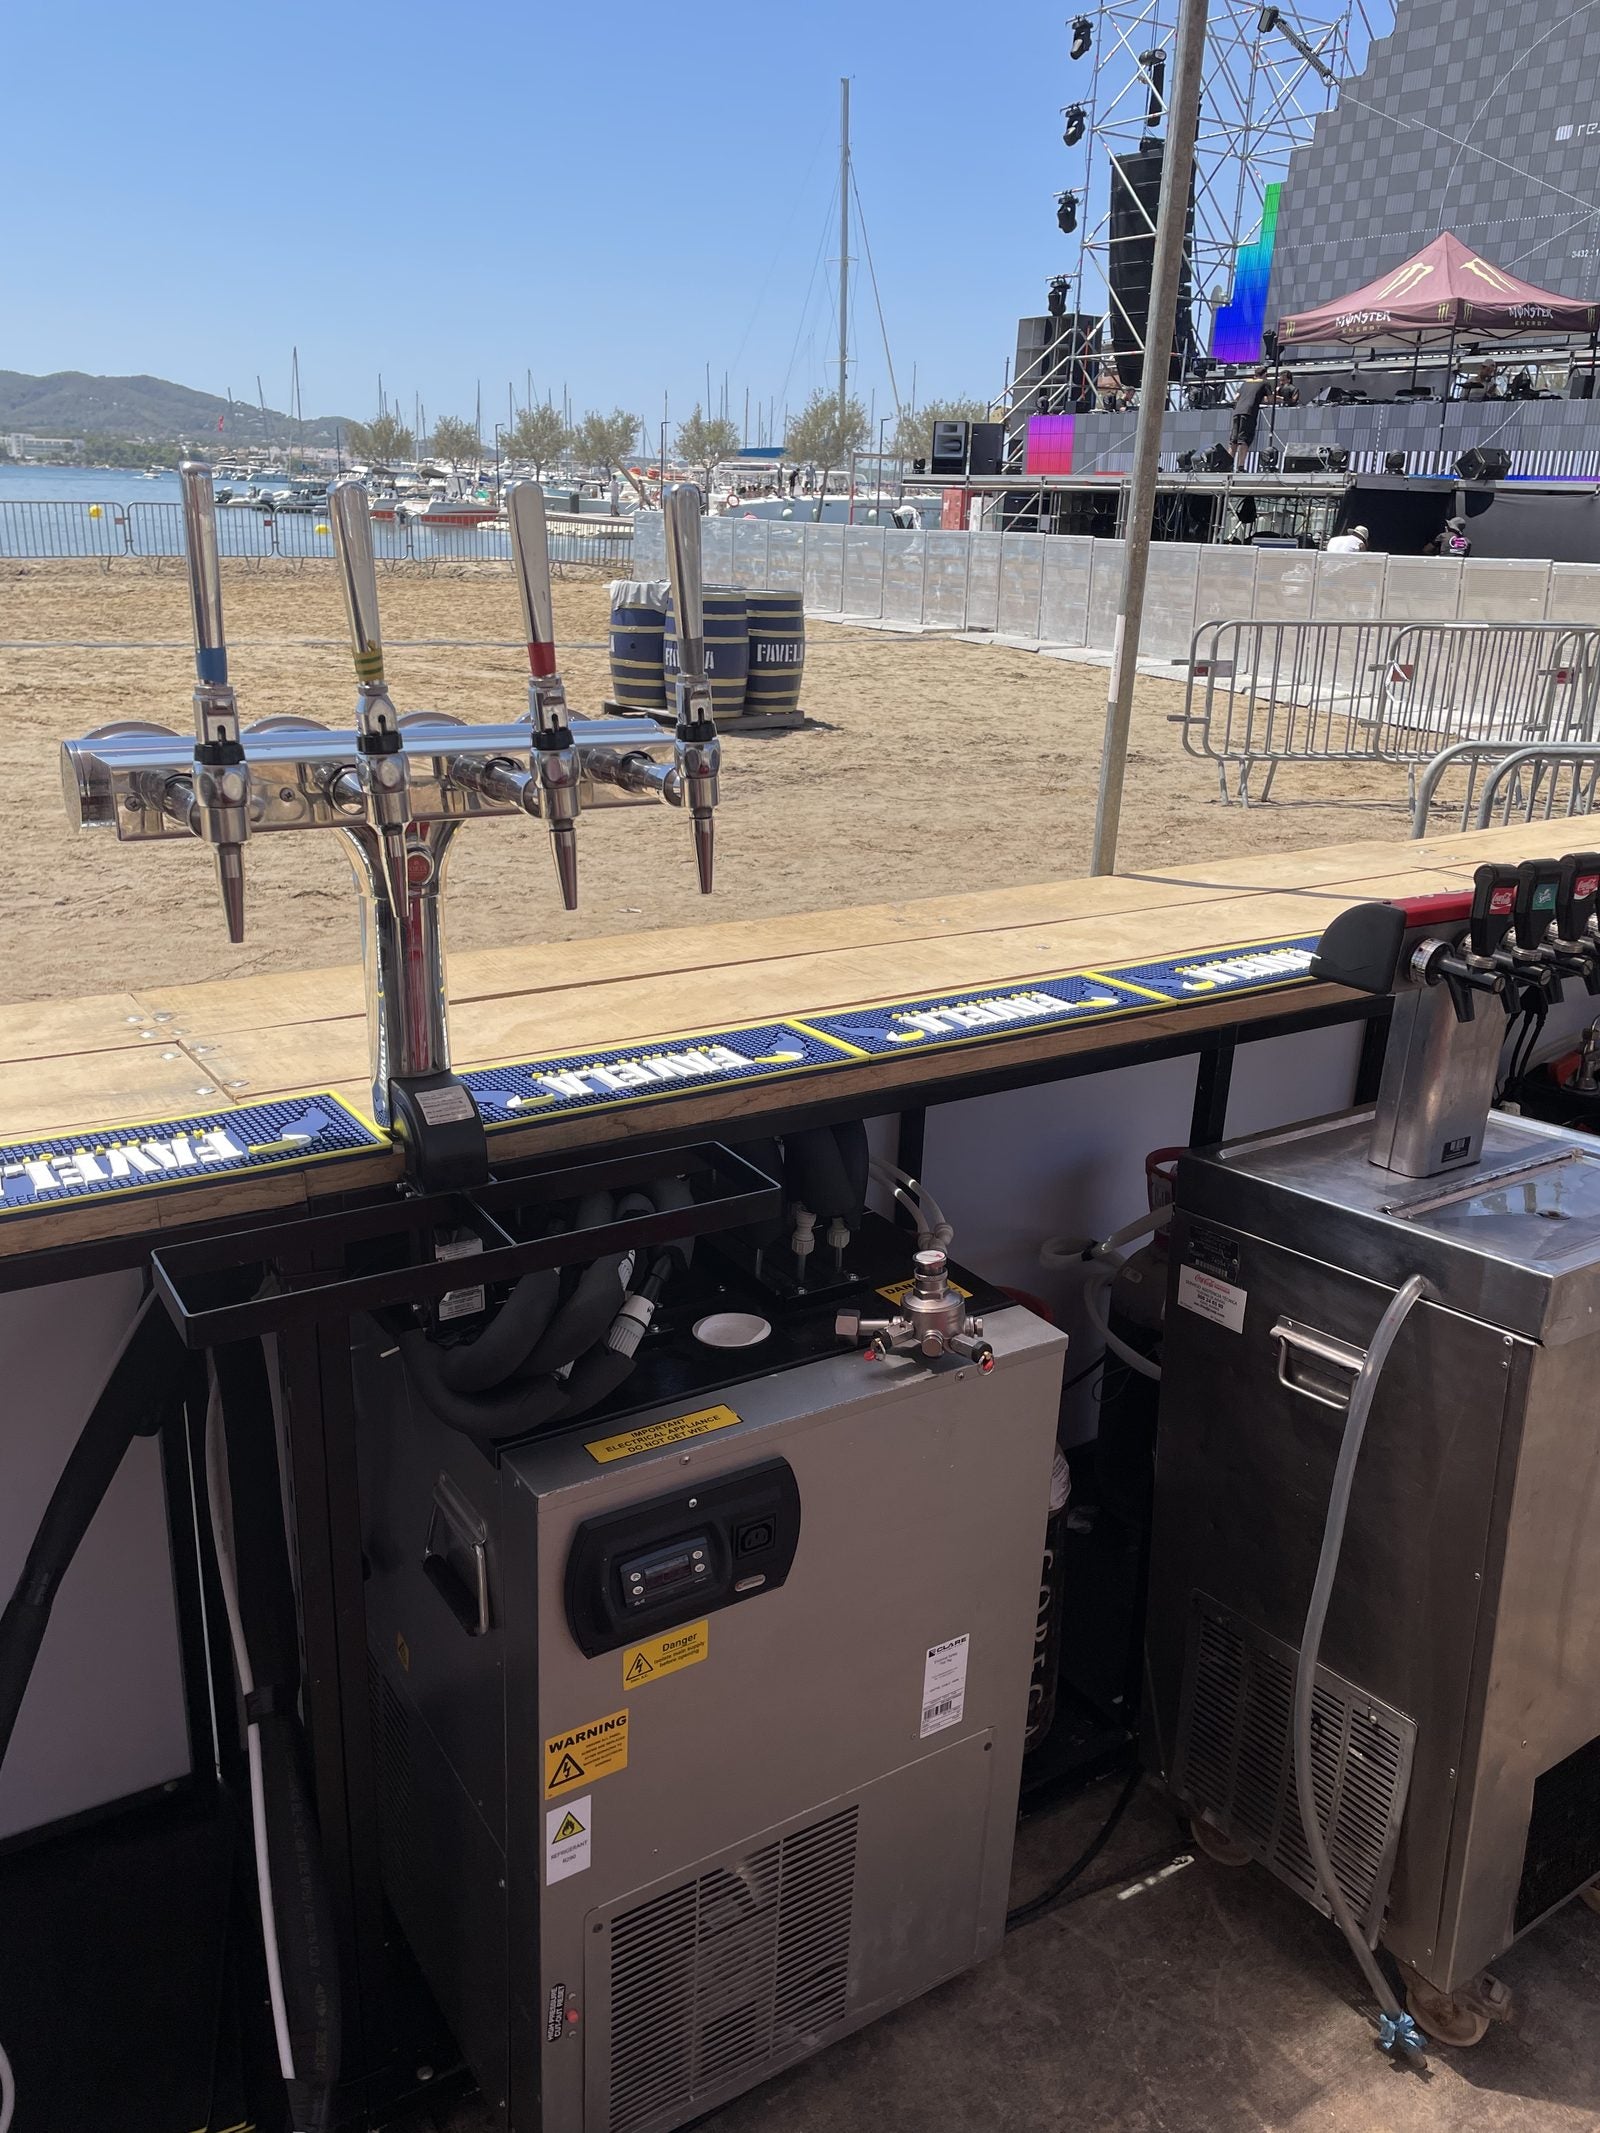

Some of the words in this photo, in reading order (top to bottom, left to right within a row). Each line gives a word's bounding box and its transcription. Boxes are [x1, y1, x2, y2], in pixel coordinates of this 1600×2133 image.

[1335, 311, 1392, 327] MONSTER
[1508, 304, 1554, 320] MONSTER
[665, 647, 715, 670] FAA
[757, 644, 804, 662] FAVEL
[897, 990, 1077, 1035] FAVELA
[534, 1044, 756, 1098] FAVELA
[0, 1127, 247, 1197] FAVEL
[884, 1281, 916, 1295] DAN
[605, 1431, 667, 1453] ELECTRICAL
[668, 1415, 721, 1434] APPLIANCE
[630, 1418, 686, 1438] IMPORTANT
[627, 1444, 643, 1453] DO
[645, 1438, 665, 1449] NOT
[667, 1431, 687, 1442] GET
[689, 1425, 710, 1437] WET
[662, 1633, 698, 1652] Danger
[936, 1637, 967, 1653] CLARE
[548, 1715, 627, 1754] WARNING
